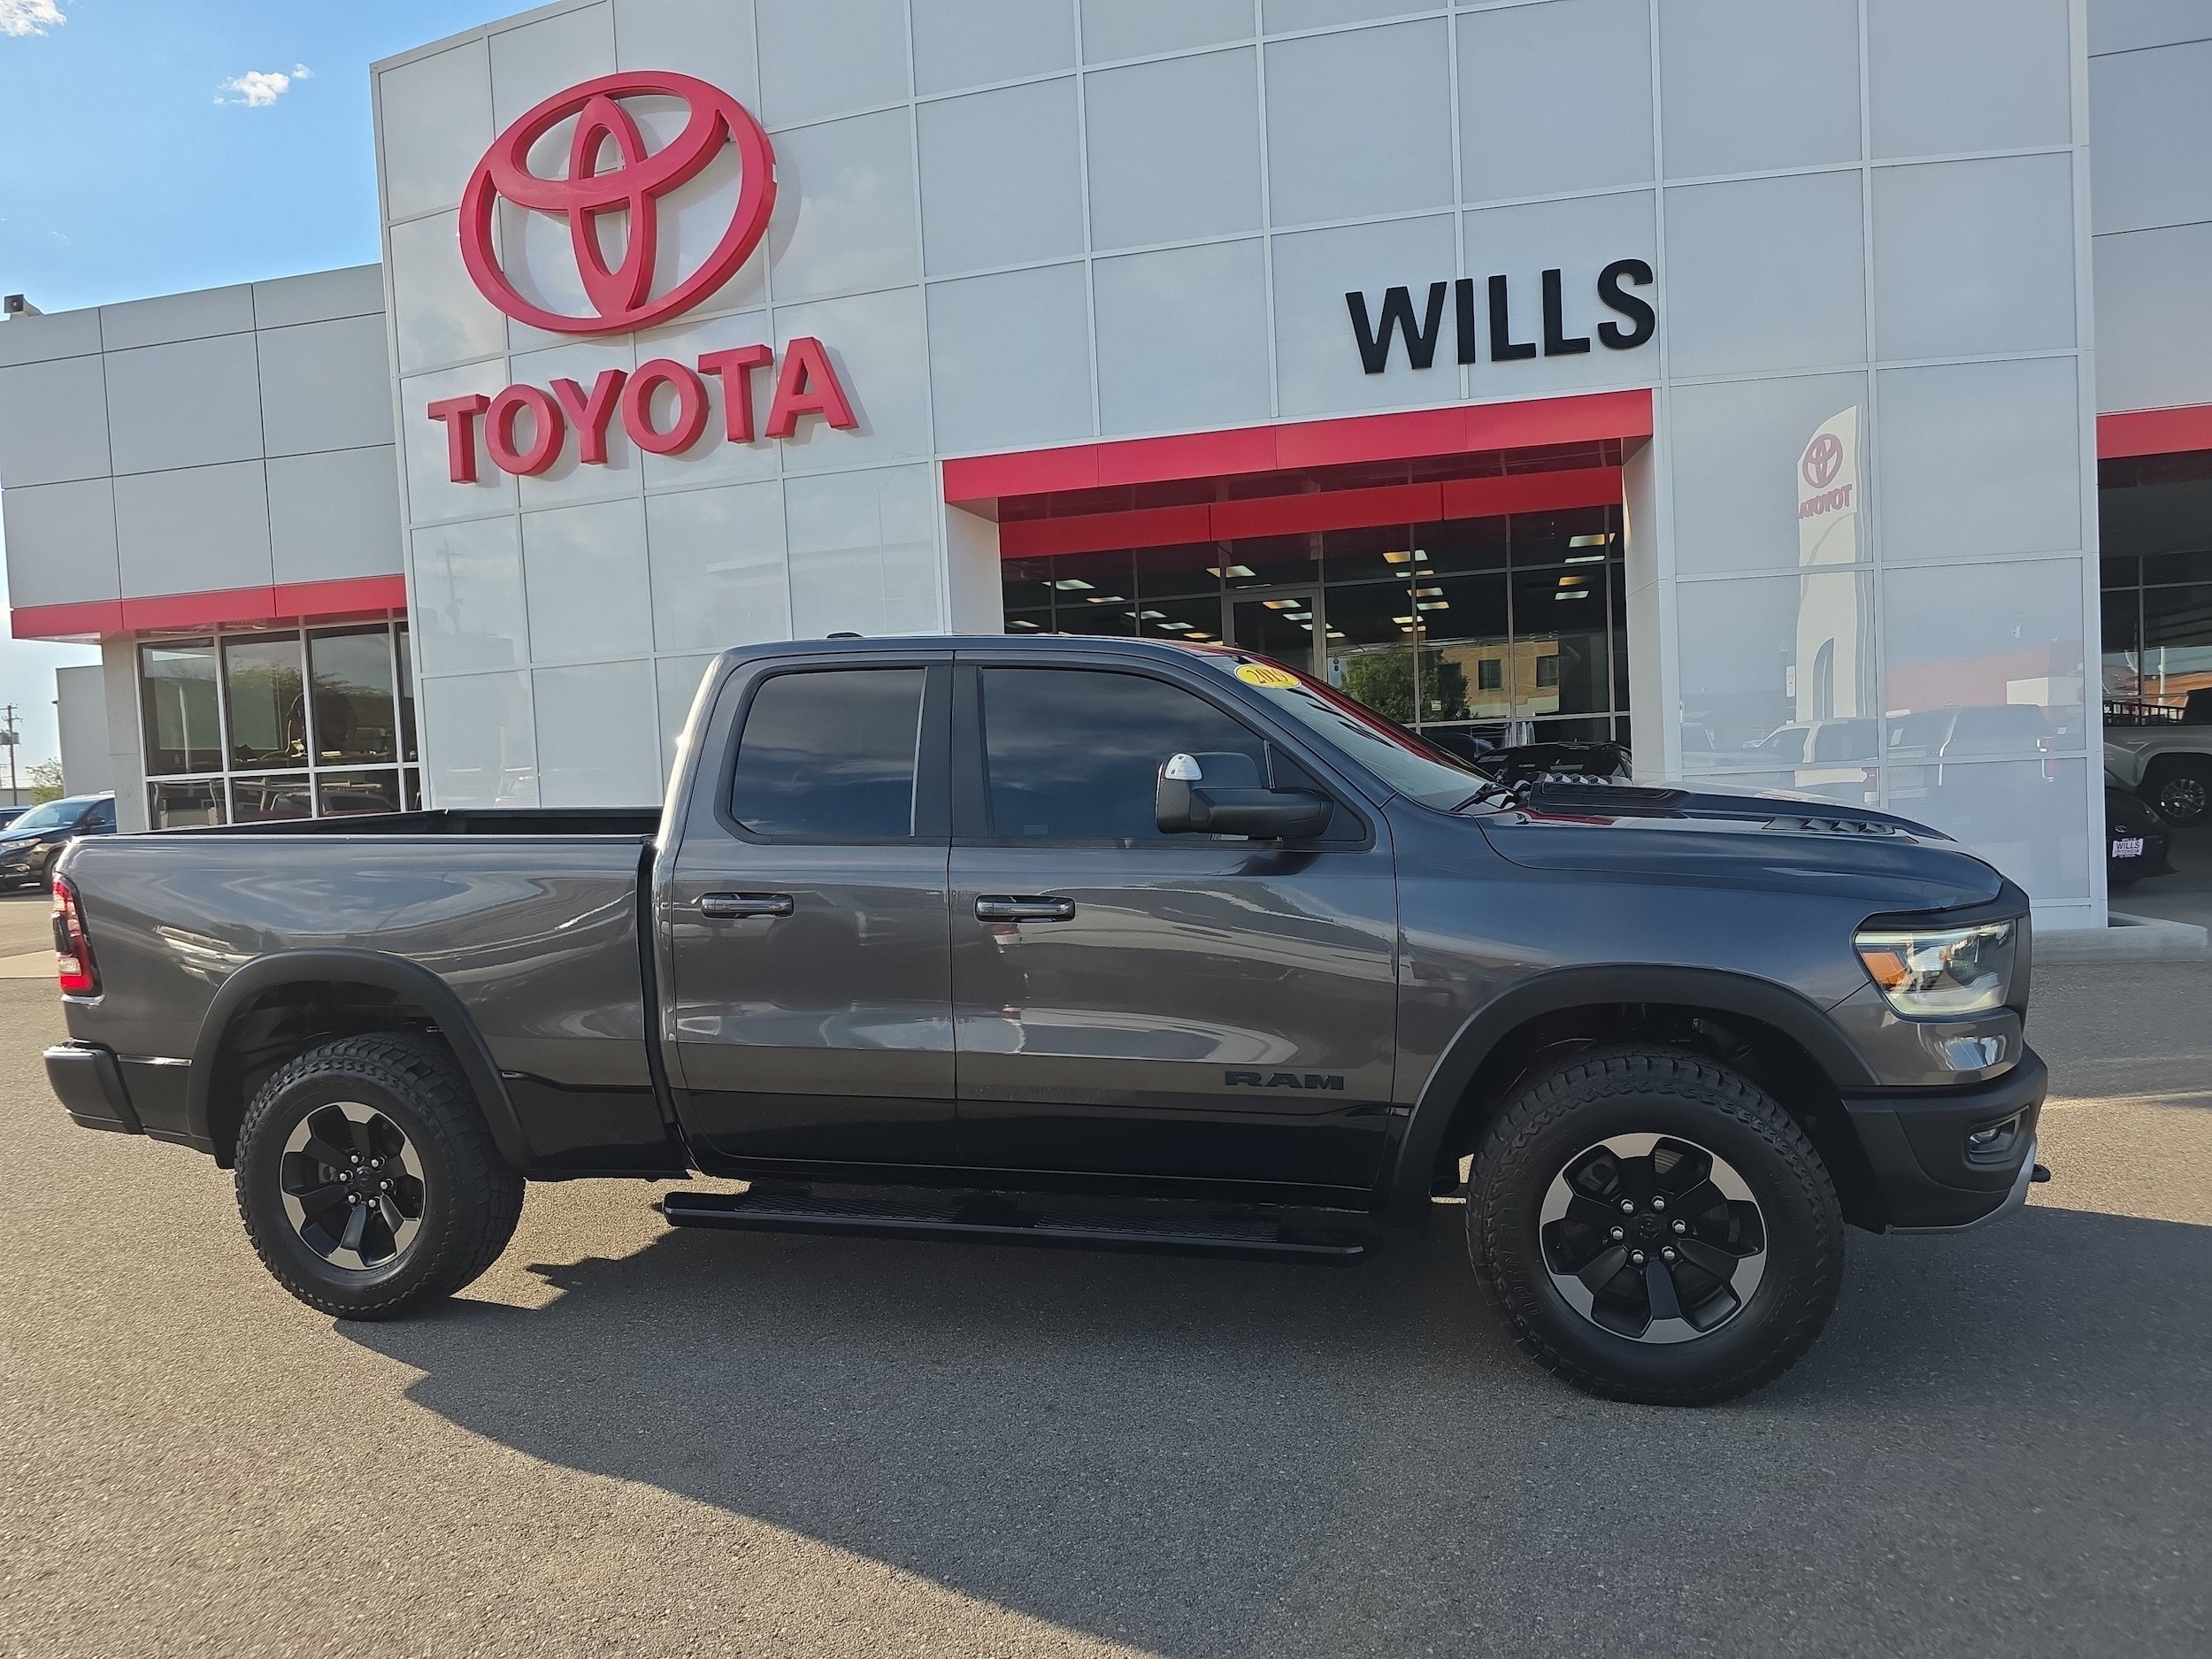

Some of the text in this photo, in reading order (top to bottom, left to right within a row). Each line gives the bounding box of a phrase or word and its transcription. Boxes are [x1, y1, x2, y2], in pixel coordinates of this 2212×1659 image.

[1345, 258, 1655, 374] WILLS
[426, 336, 859, 484] TOYOTA
[1246, 668, 1288, 685] 2019
[2116, 841, 2139, 849] WILLS
[1225, 1071, 1344, 1091] RAM
